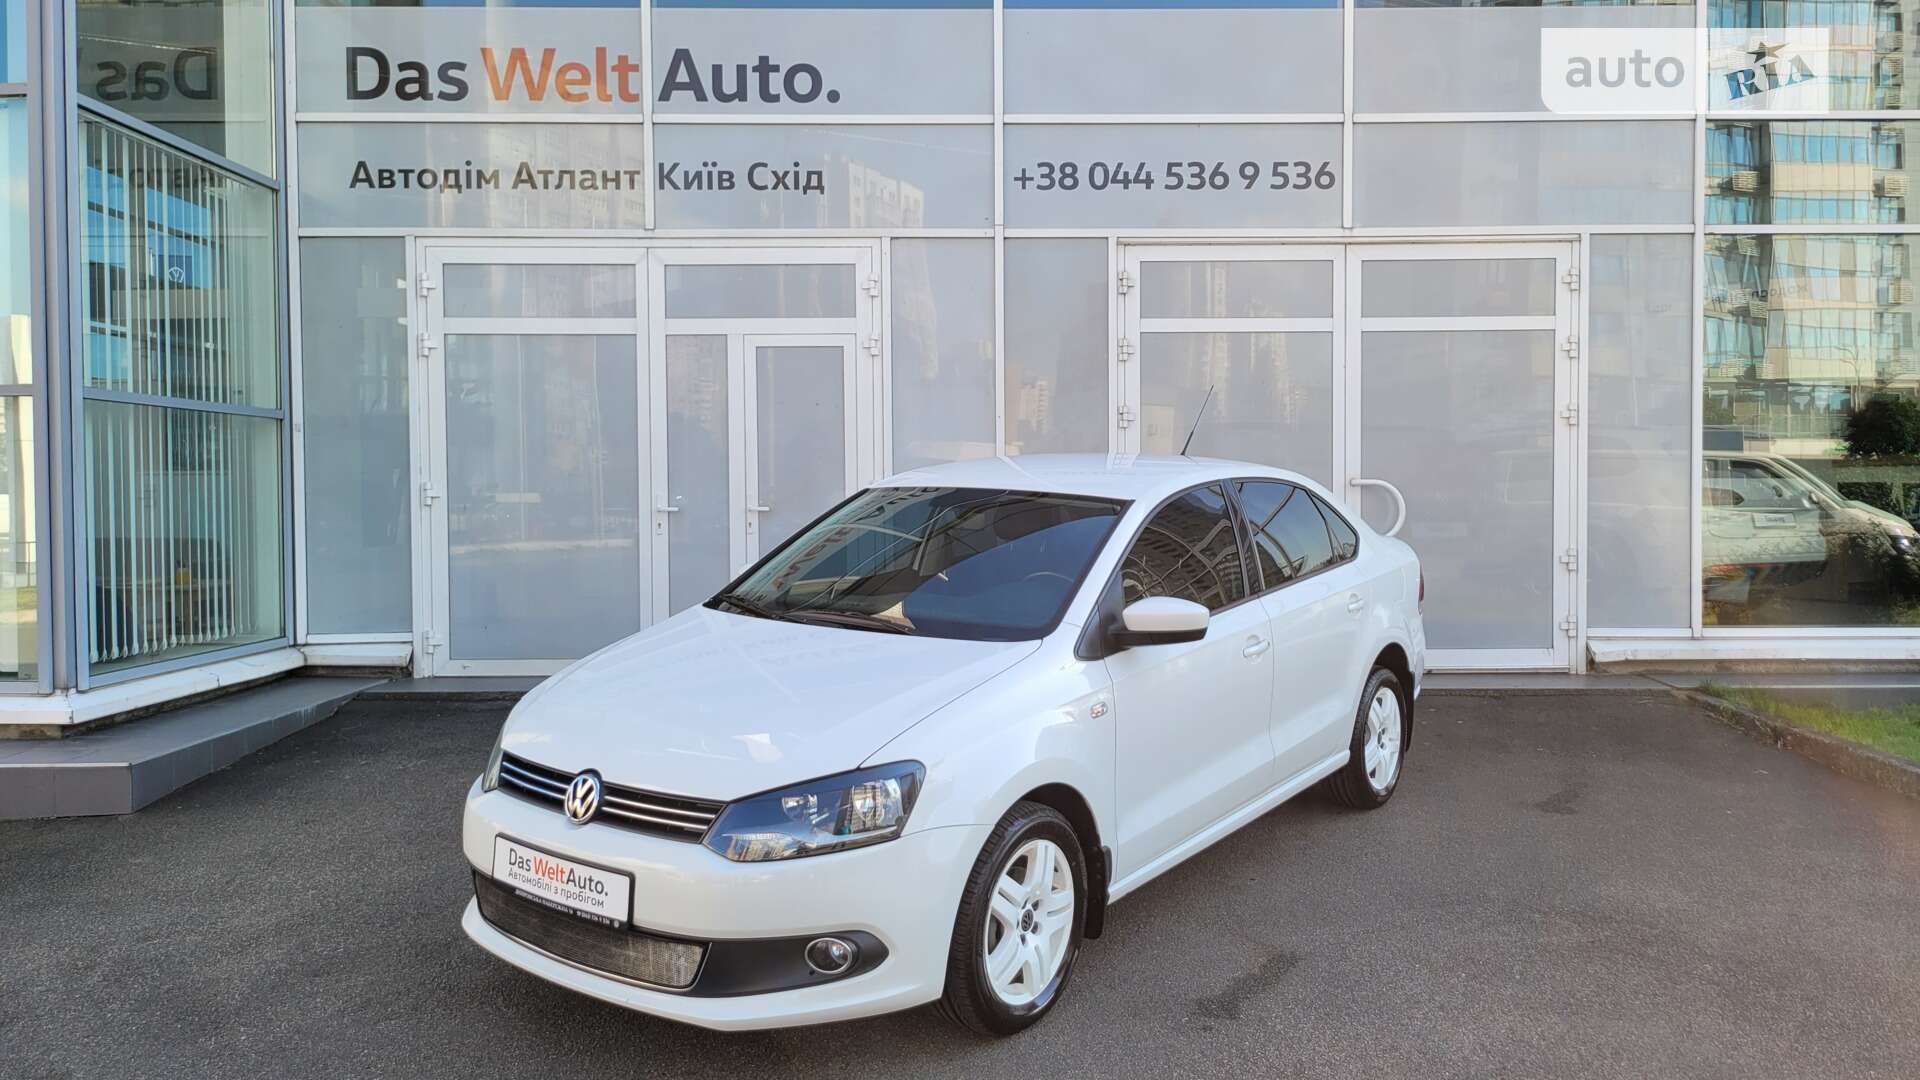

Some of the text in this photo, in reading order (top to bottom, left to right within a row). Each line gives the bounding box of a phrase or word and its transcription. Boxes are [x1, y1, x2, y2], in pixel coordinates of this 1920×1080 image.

[346, 46, 841, 103] Das Welt Auto.
[349, 159, 825, 195] Автодім Атлант Київ Схід
[1013, 161, 1337, 191] +38 044 536 9 536
[508, 847, 608, 897] Das Welt Auto.
